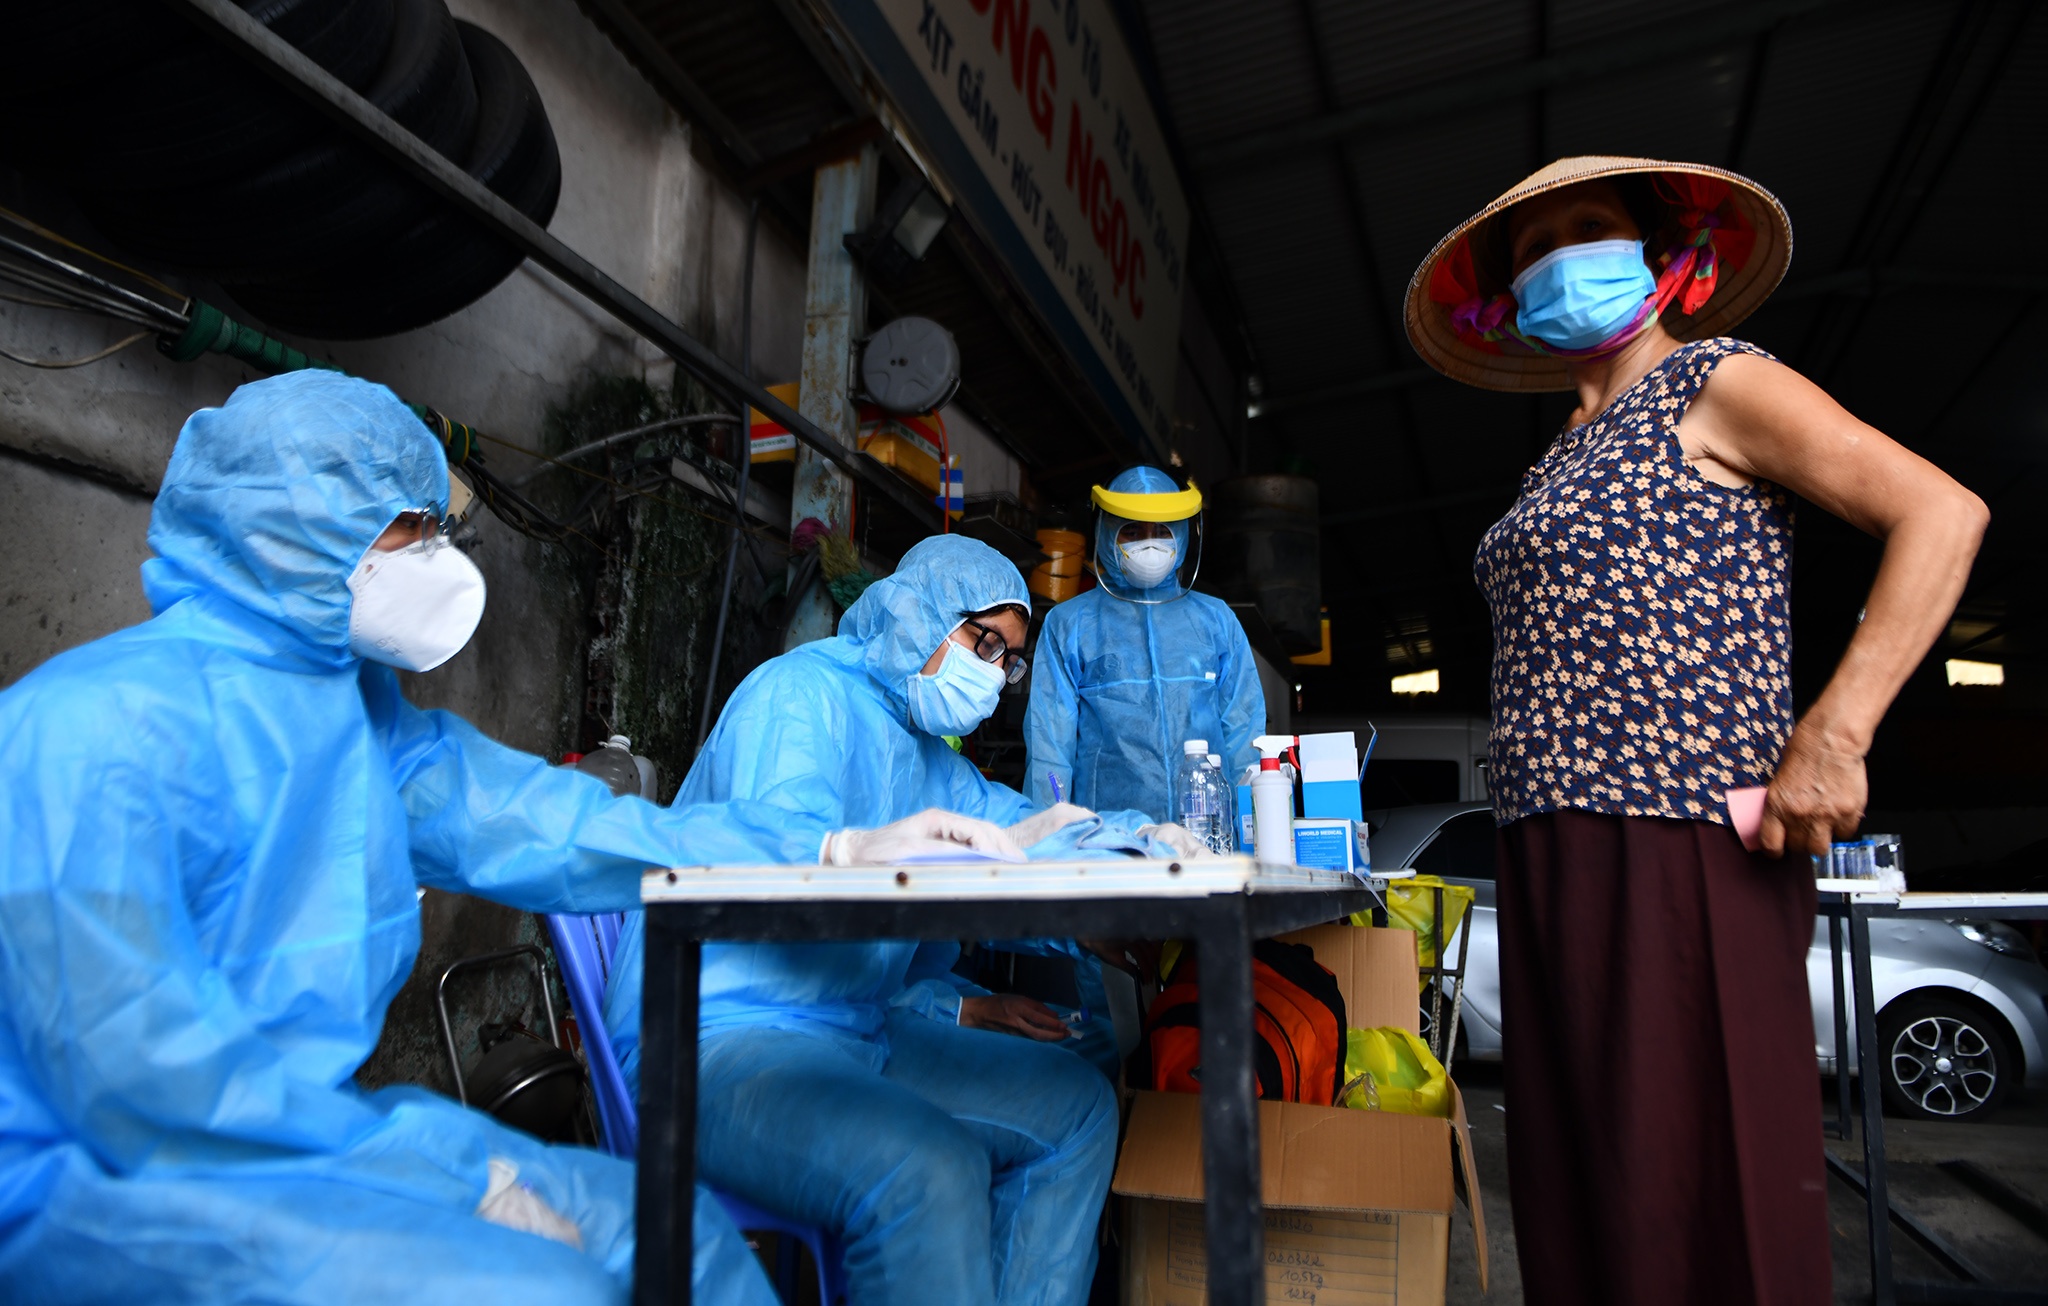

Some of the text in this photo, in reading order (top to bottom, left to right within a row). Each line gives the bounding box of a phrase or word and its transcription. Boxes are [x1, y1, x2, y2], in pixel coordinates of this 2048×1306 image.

[918, 0, 954, 77] XỊT
[1011, 152, 1042, 226] HÚT
[967, 0, 1146, 322] NG NGỌC
